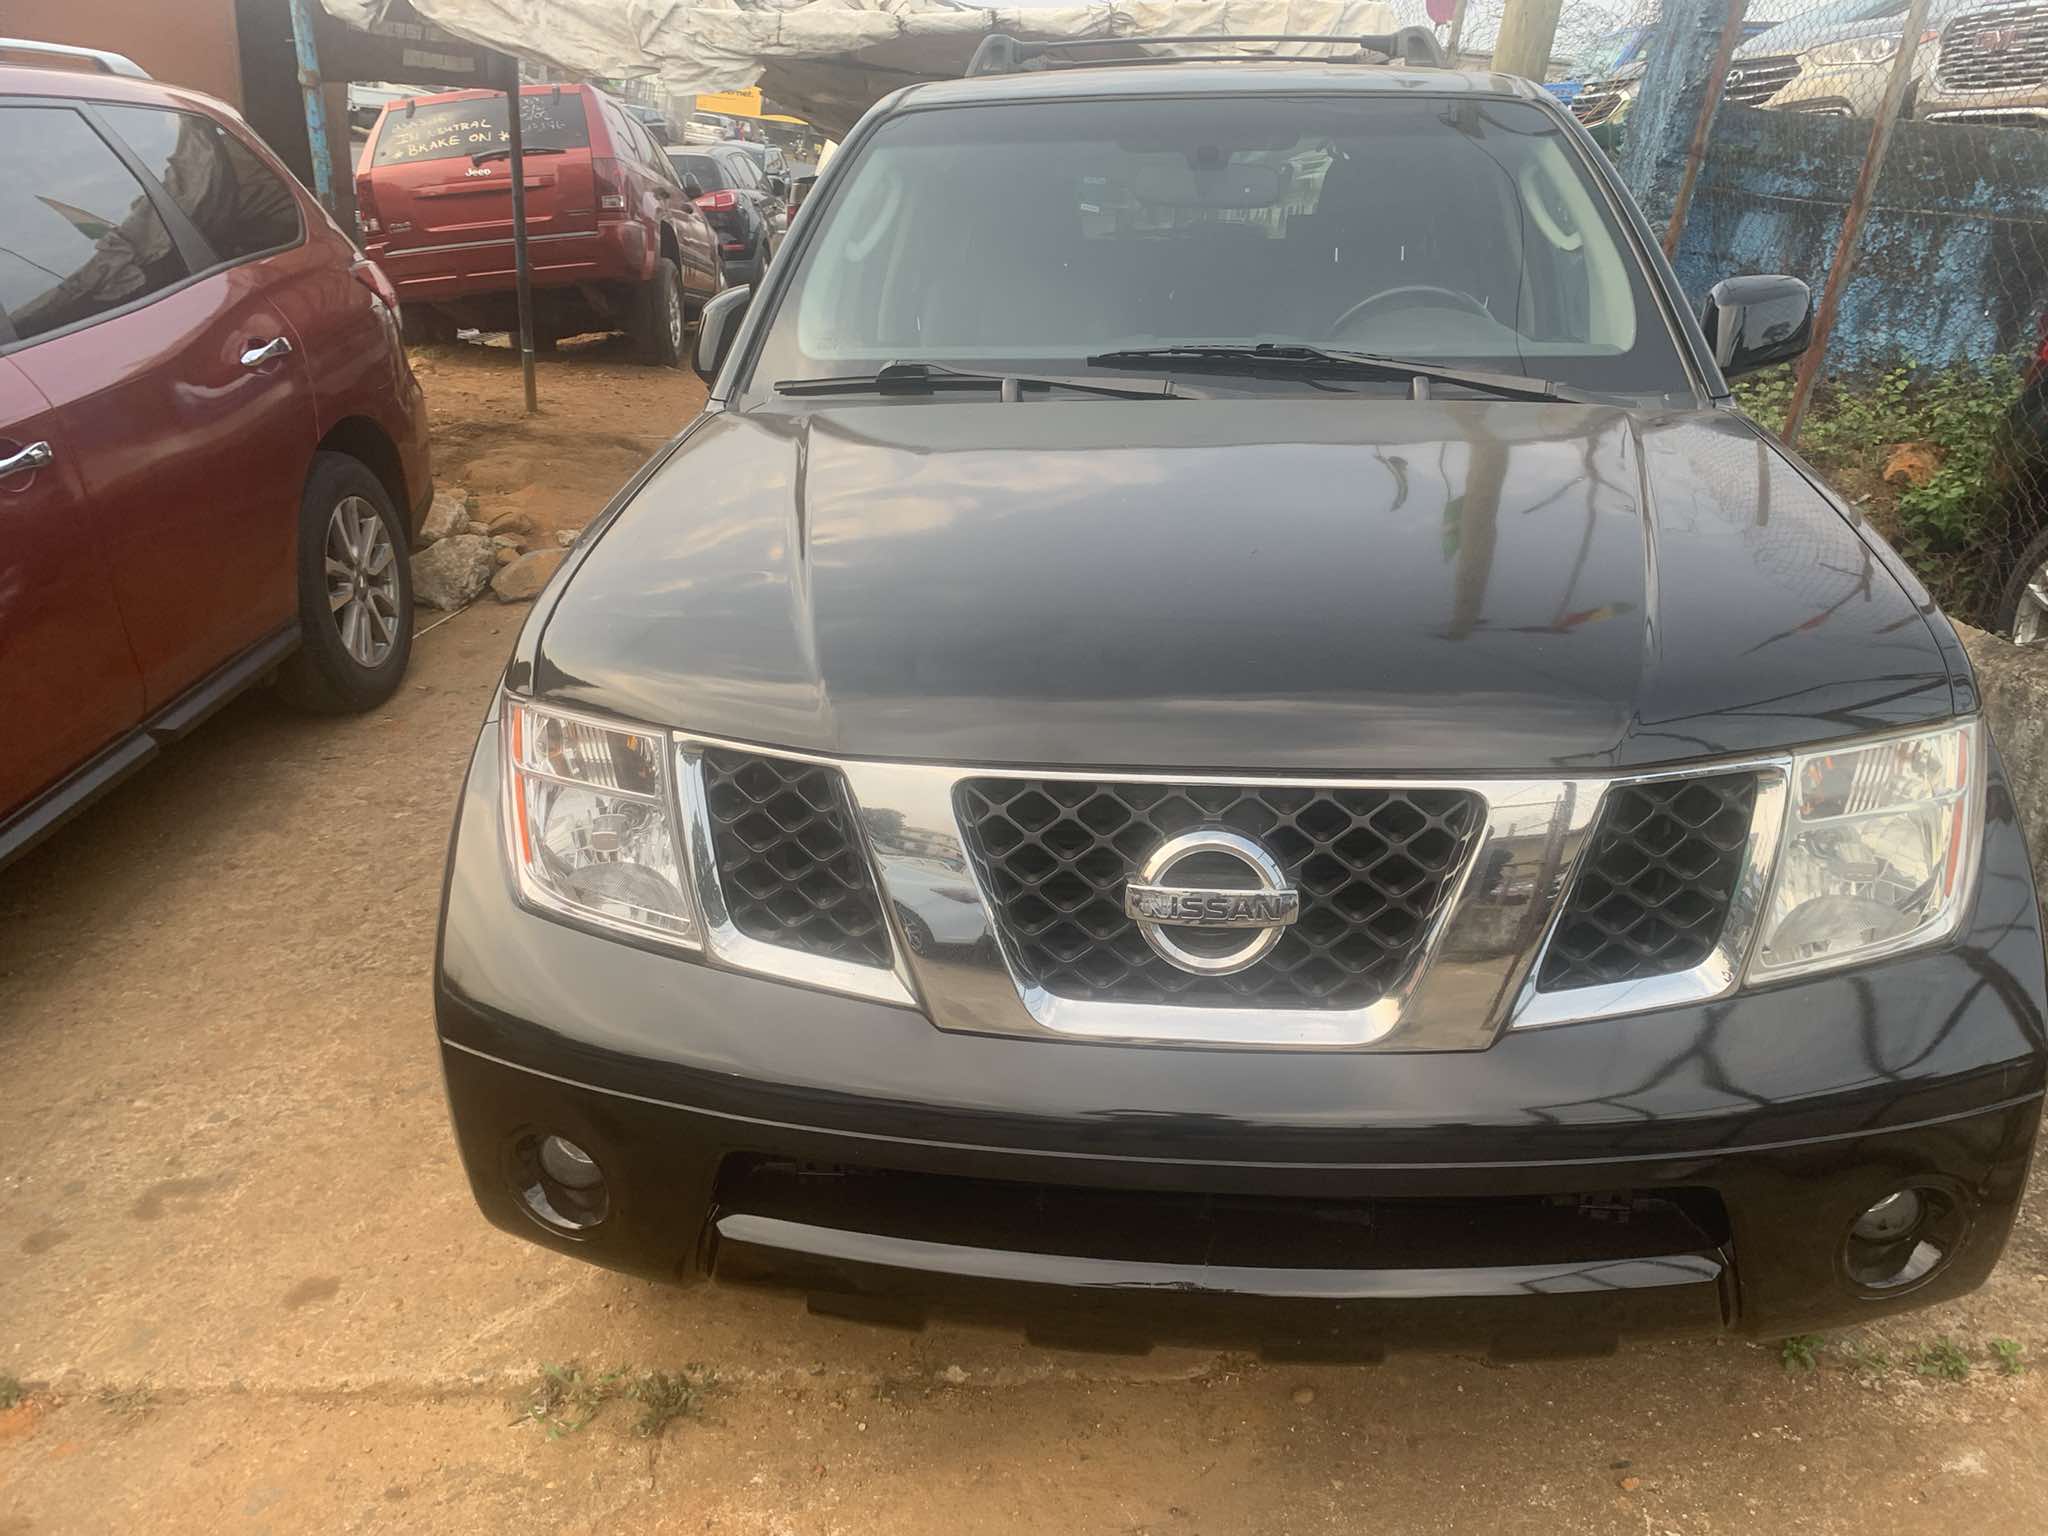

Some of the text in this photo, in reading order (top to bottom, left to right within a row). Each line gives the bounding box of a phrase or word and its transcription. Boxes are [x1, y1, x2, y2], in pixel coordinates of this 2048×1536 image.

[407, 130, 492, 157] BRAKE ON
[464, 167, 492, 177] Jeep
[1141, 894, 1283, 921] NISSAN
